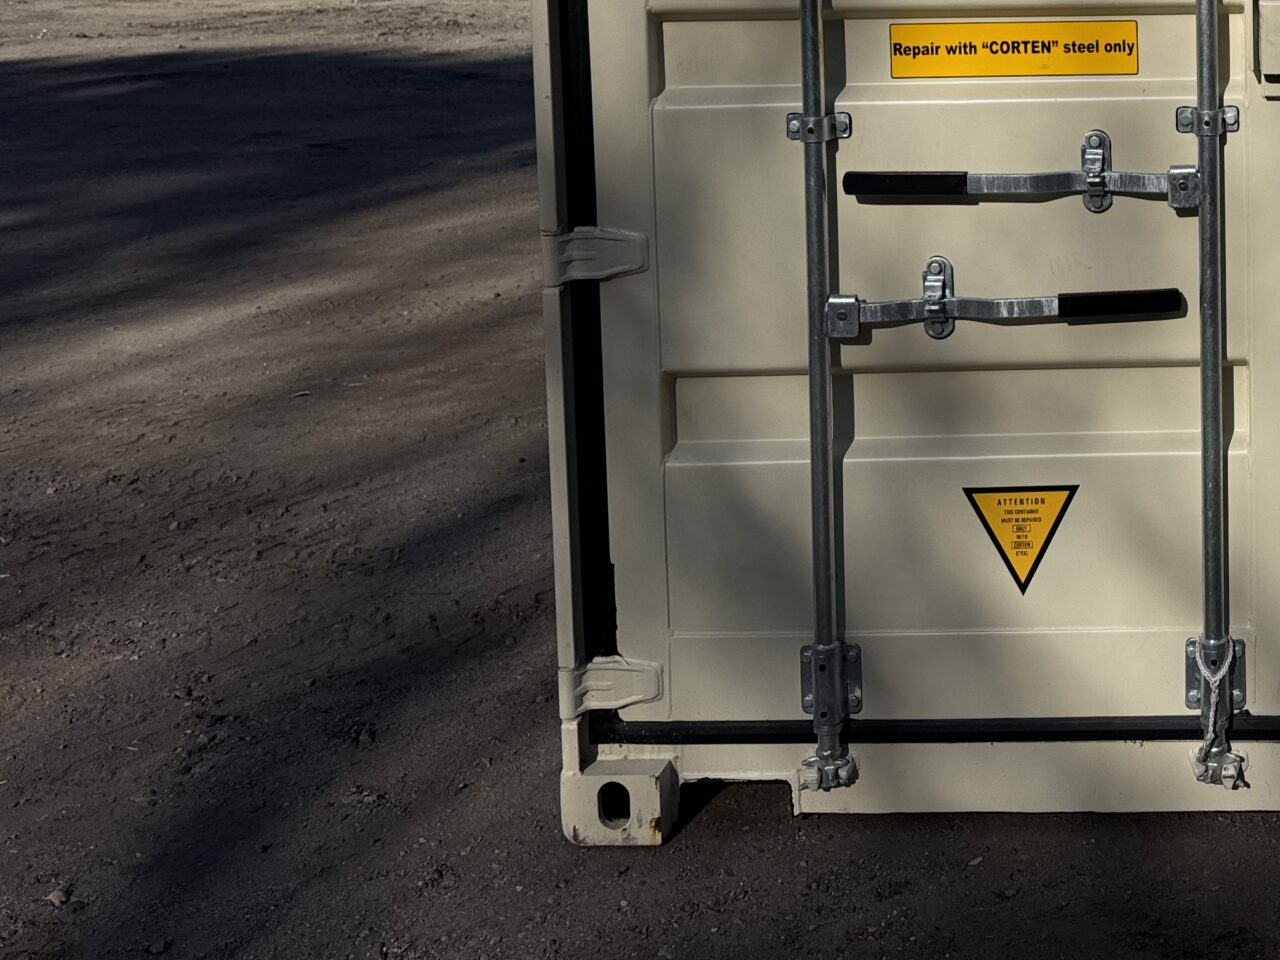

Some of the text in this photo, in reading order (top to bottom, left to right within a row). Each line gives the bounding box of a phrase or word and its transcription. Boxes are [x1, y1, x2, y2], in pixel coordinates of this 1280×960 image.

[893, 42, 940, 59] Repair
[945, 41, 977, 56] with
[1063, 39, 1099, 54] steel
[1104, 39, 1135, 56] only
[997, 498, 1046, 506] ATTENTION
